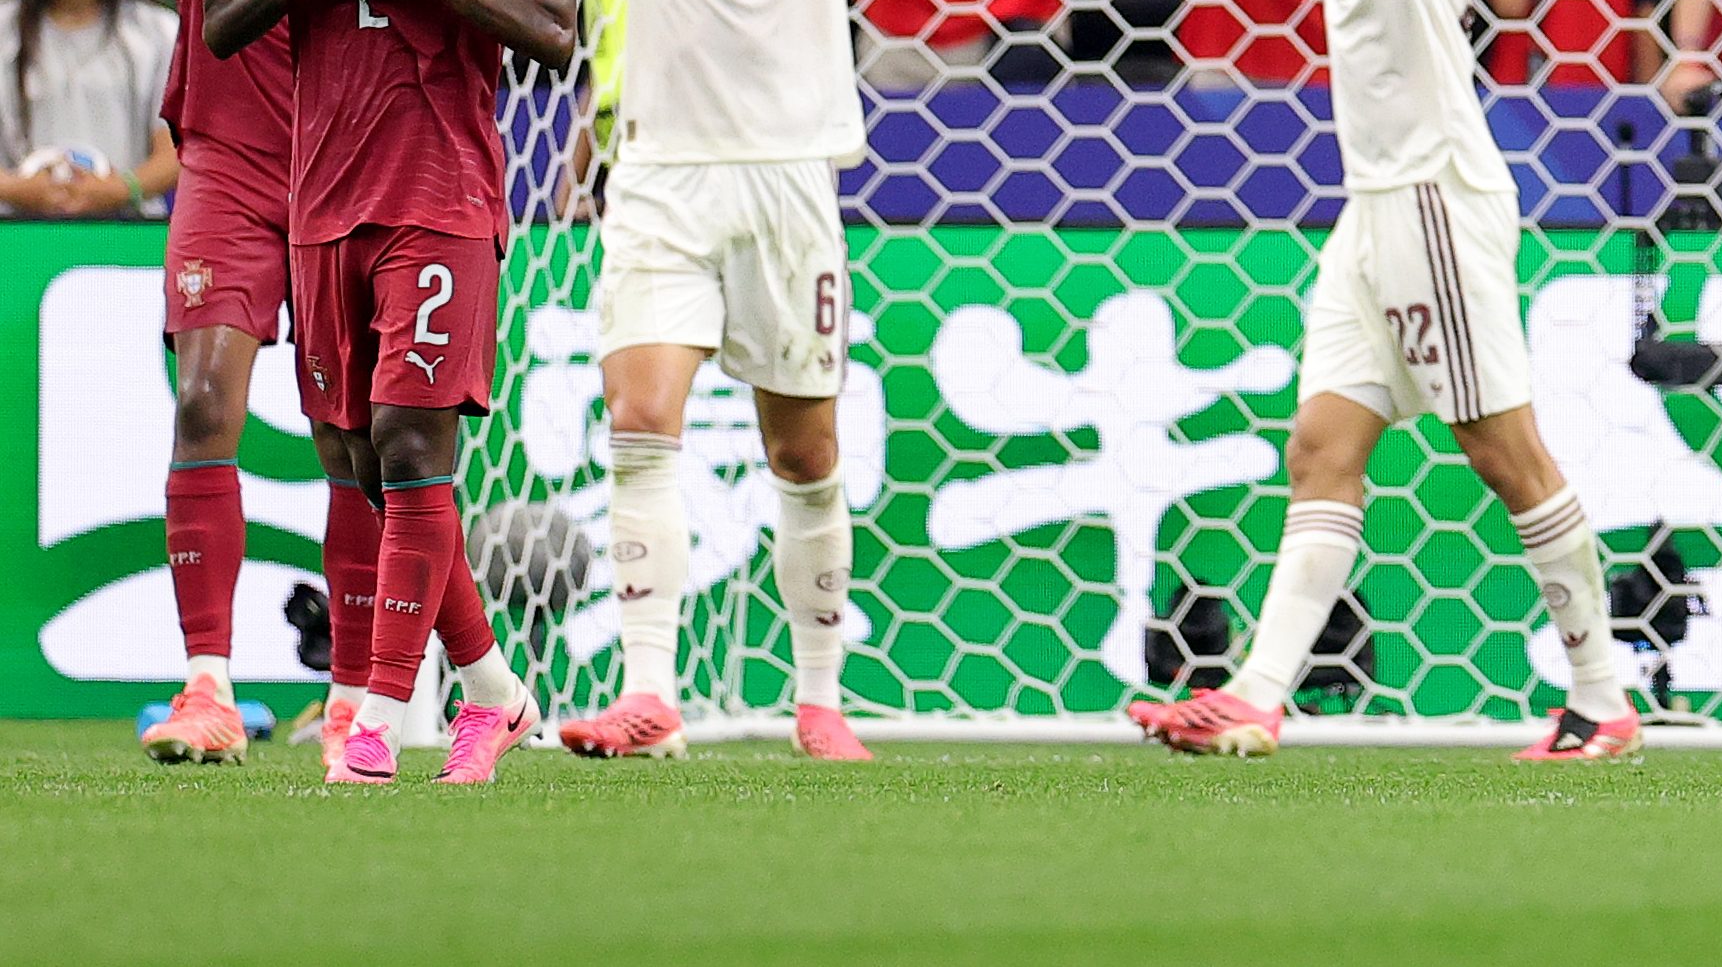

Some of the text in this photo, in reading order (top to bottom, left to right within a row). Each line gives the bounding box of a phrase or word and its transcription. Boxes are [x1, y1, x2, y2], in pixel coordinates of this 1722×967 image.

[413, 263, 454, 346] 2
[815, 272, 836, 336] 6
[1384, 302, 1440, 366] 22
